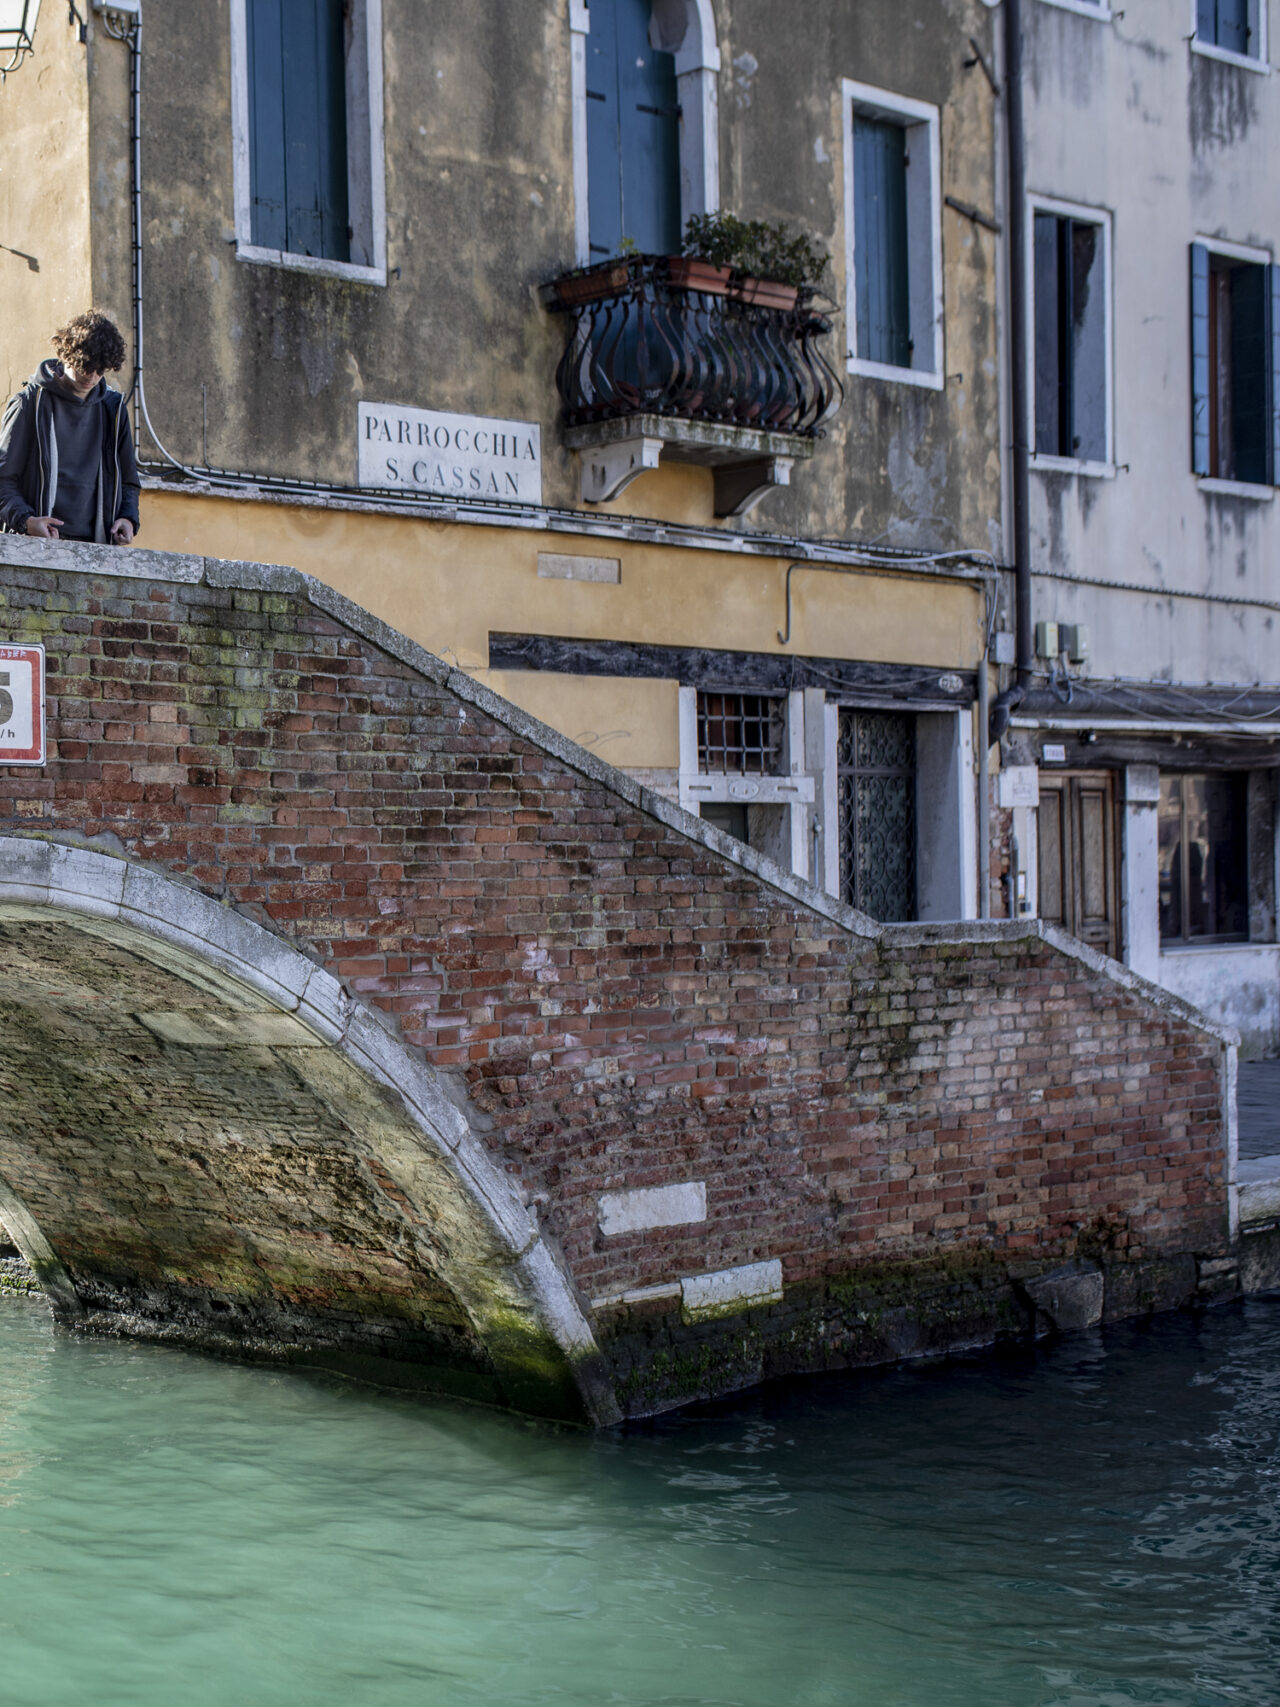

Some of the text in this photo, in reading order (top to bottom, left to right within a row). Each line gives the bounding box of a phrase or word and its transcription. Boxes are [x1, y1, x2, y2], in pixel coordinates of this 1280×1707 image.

[365, 416, 536, 460] PARROCCHIA
[386, 457, 520, 495] S. CASSAN
